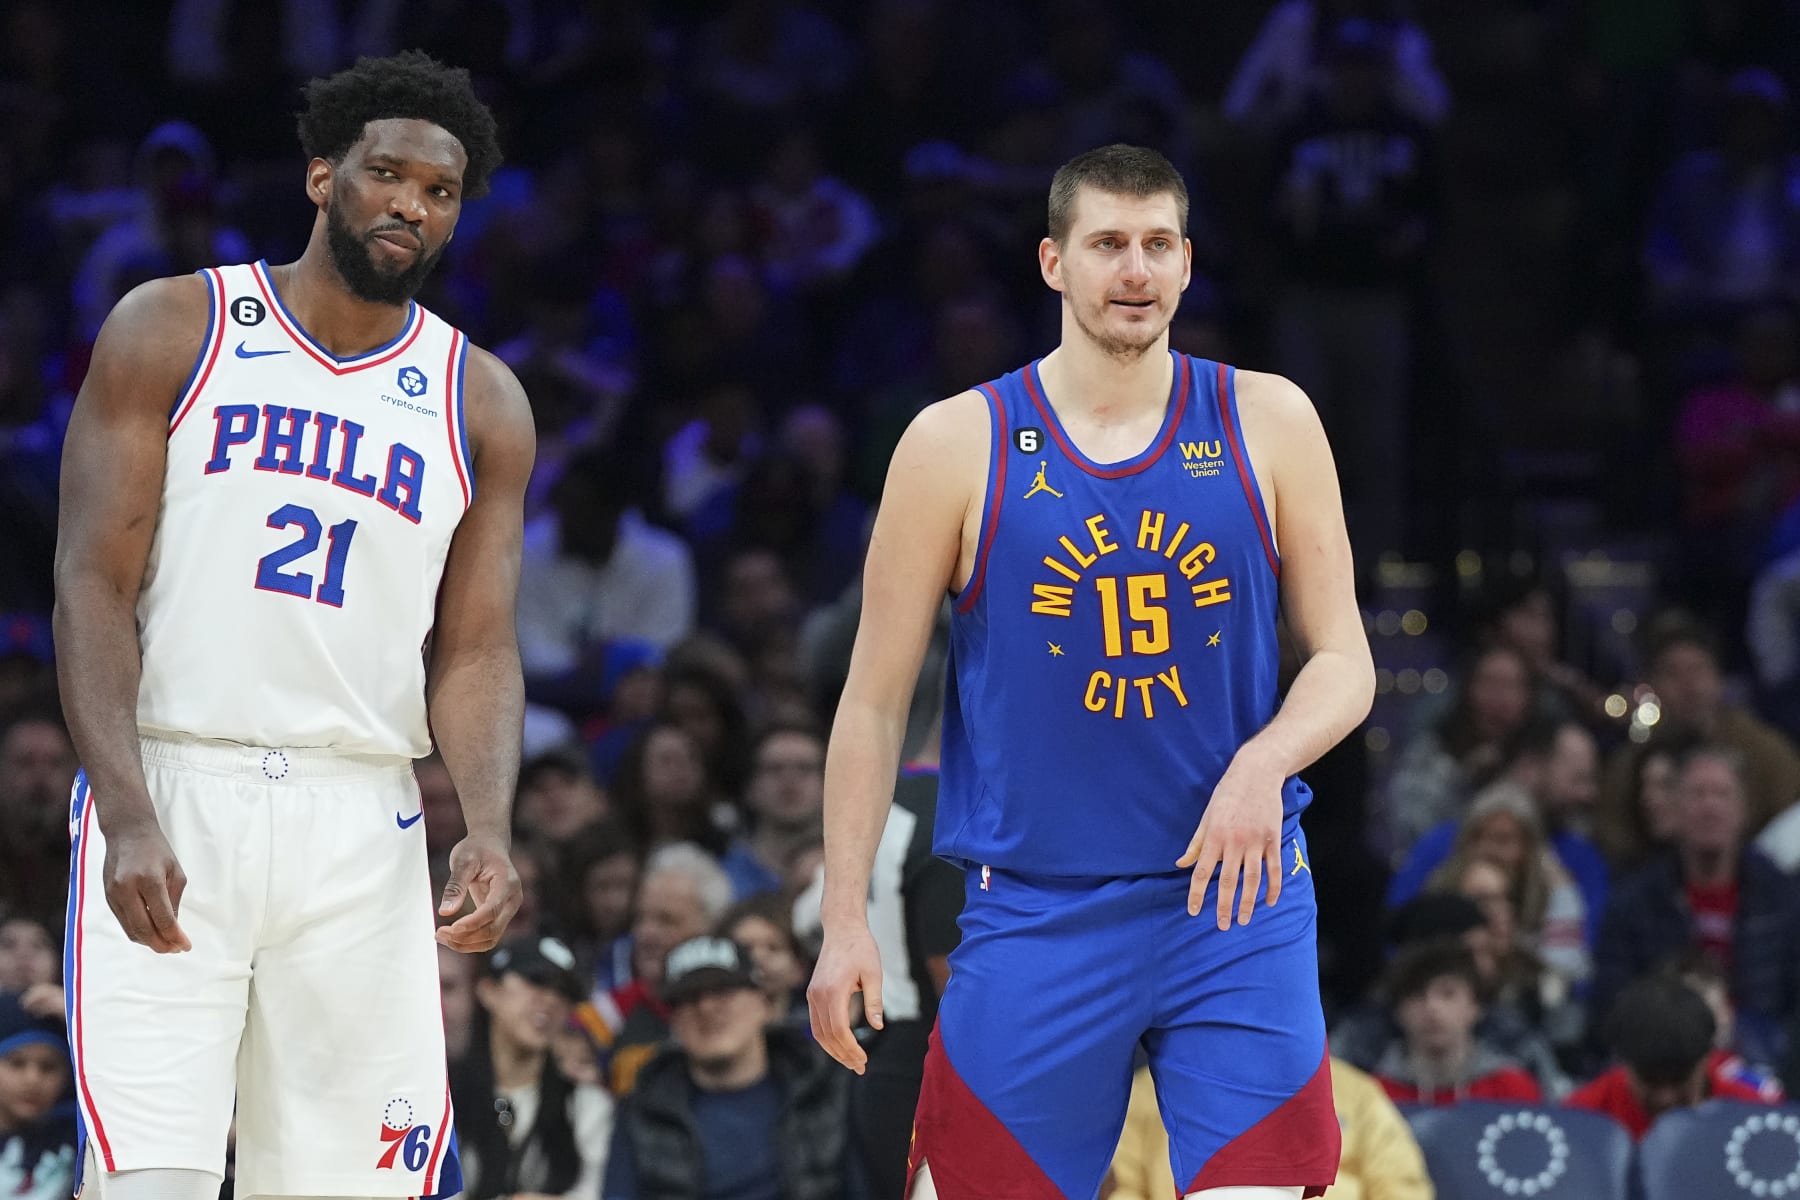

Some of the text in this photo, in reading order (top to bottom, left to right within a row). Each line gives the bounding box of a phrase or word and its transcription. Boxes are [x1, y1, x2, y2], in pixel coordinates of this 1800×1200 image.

[238, 300, 258, 323] 6
[381, 394, 438, 418] crypto.com
[1018, 430, 1037, 451] 6
[1179, 439, 1222, 460] WU
[204, 404, 426, 525] PHILA
[1182, 460, 1225, 470] Western
[1191, 468, 1220, 478] Union
[254, 503, 358, 609] 21
[1030, 510, 1232, 617] MILE HIGH
[1096, 573, 1170, 658] 15
[1084, 665, 1188, 719] CITY
[375, 1122, 431, 1172] 76
